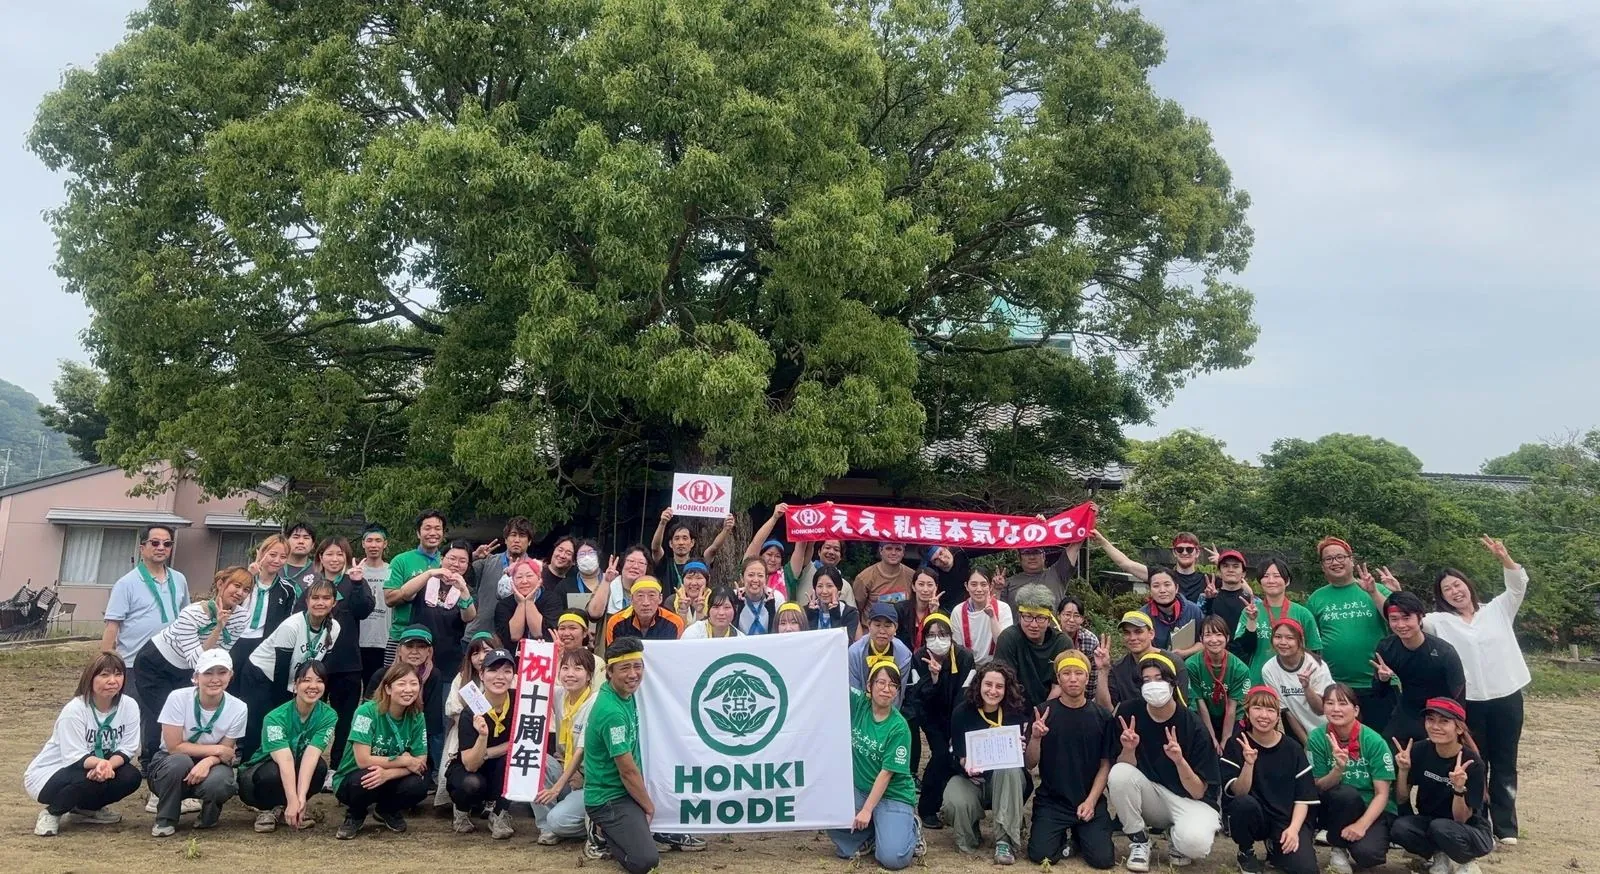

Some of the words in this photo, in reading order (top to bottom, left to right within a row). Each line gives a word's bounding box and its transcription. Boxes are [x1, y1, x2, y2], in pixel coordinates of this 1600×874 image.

[831, 509, 1086, 544] ええ、私達本気なので。
[509, 652, 553, 776] 祝十周年
[674, 761, 805, 794] HONKI
[680, 795, 796, 825] MODE
